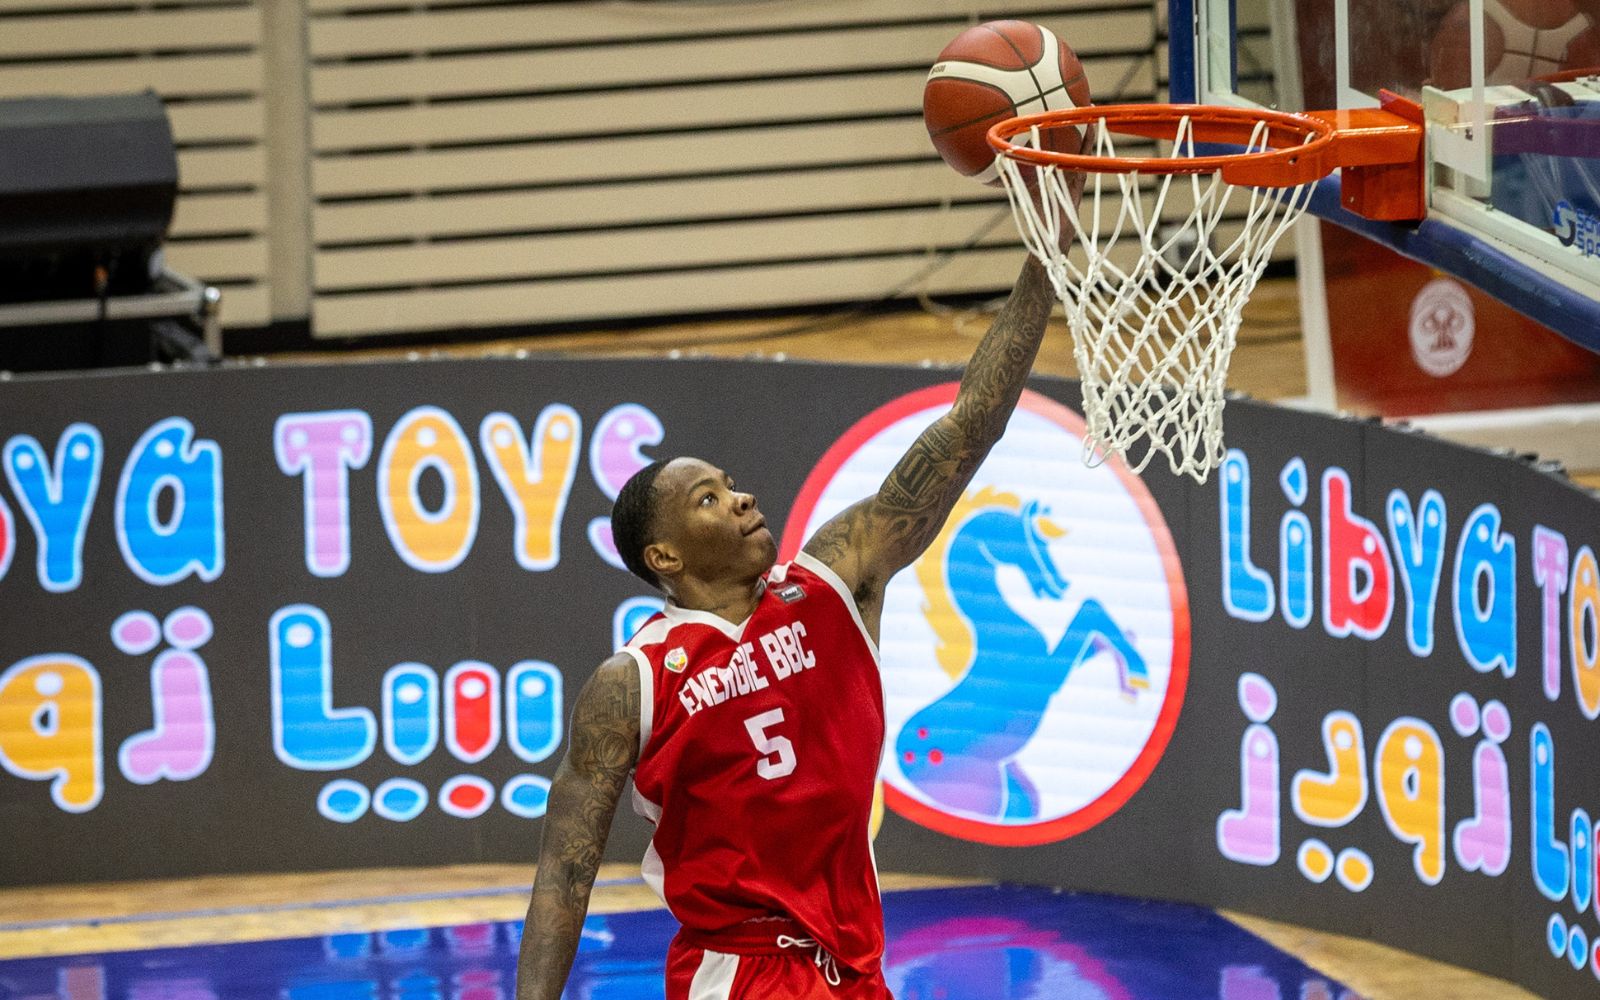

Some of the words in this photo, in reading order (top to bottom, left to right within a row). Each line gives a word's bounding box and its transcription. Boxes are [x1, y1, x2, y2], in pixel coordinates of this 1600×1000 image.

[274, 403, 666, 578] TOYS
[759, 620, 816, 681] BBC
[743, 707, 797, 780] 5
